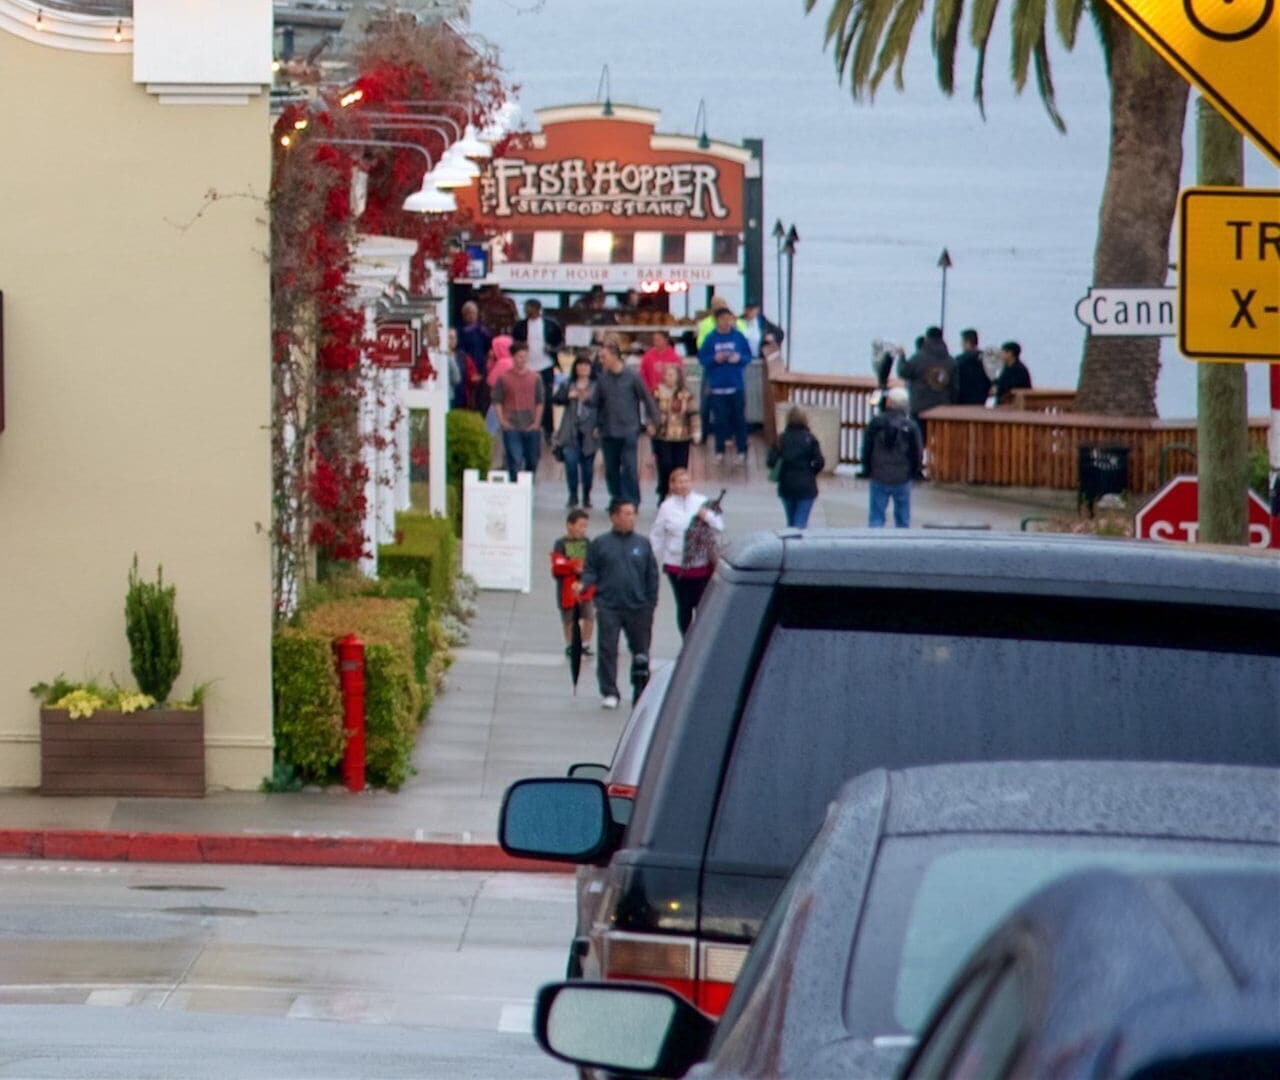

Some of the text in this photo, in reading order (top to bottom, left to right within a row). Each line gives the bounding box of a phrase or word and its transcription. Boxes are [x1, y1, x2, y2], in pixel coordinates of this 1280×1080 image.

[494, 159, 728, 218] FISH HOPPER
[518, 199, 686, 216] SEAFOOD STEAKS
[510, 268, 558, 280] HAPPY
[566, 268, 609, 280] HOUR
[670, 268, 711, 280] MENU
[1149, 520, 1271, 549] STP
